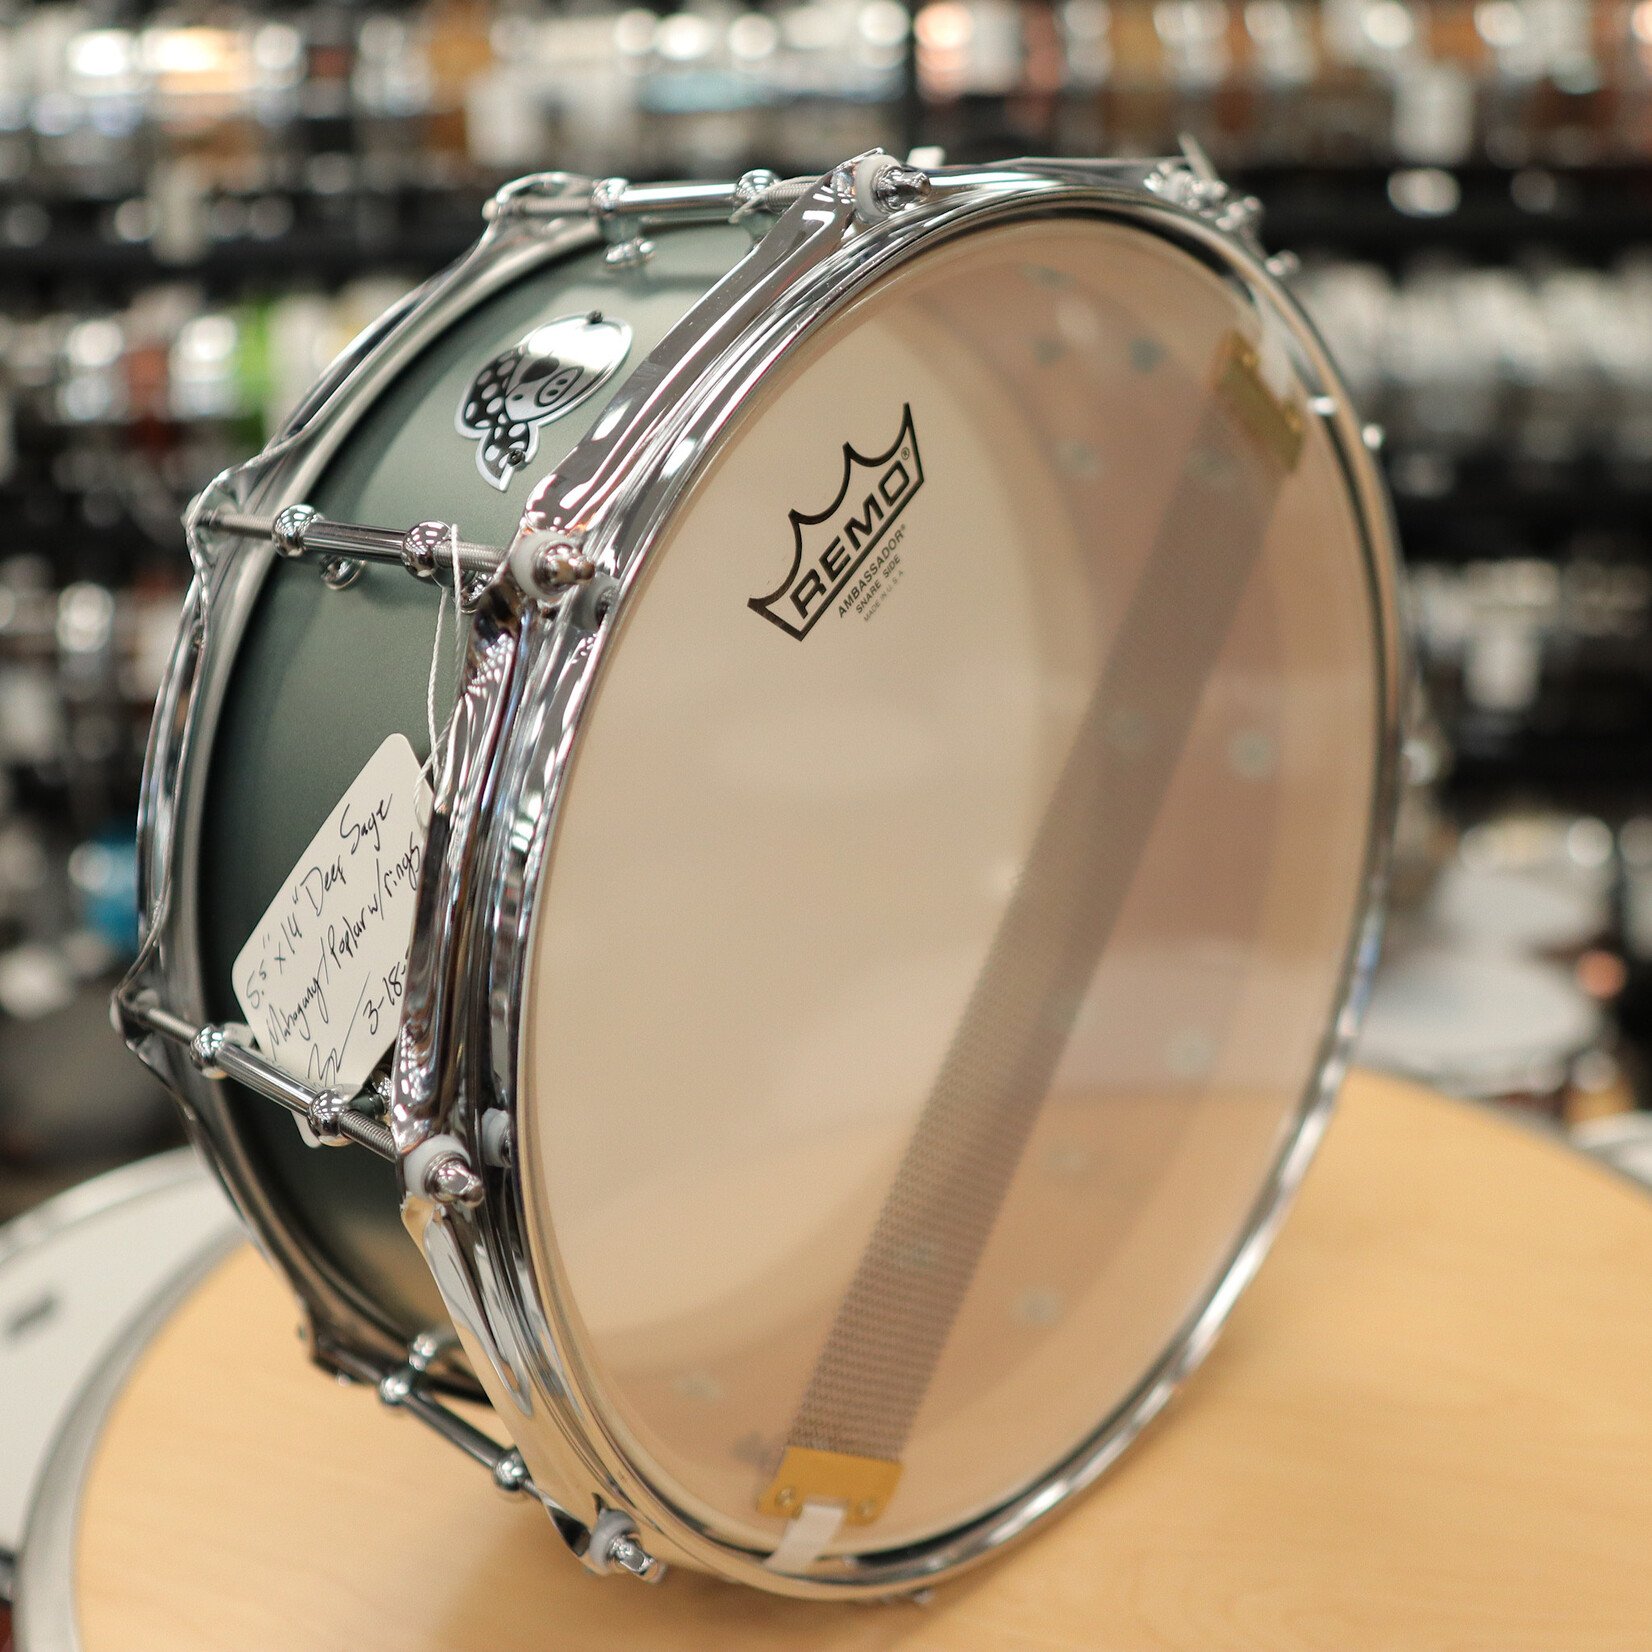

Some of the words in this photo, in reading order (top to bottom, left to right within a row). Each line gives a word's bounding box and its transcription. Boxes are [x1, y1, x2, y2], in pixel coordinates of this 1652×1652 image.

[855, 579, 882, 614] SNARE
[882, 554, 901, 578] SIDE
[339, 793, 393, 855] Sage
